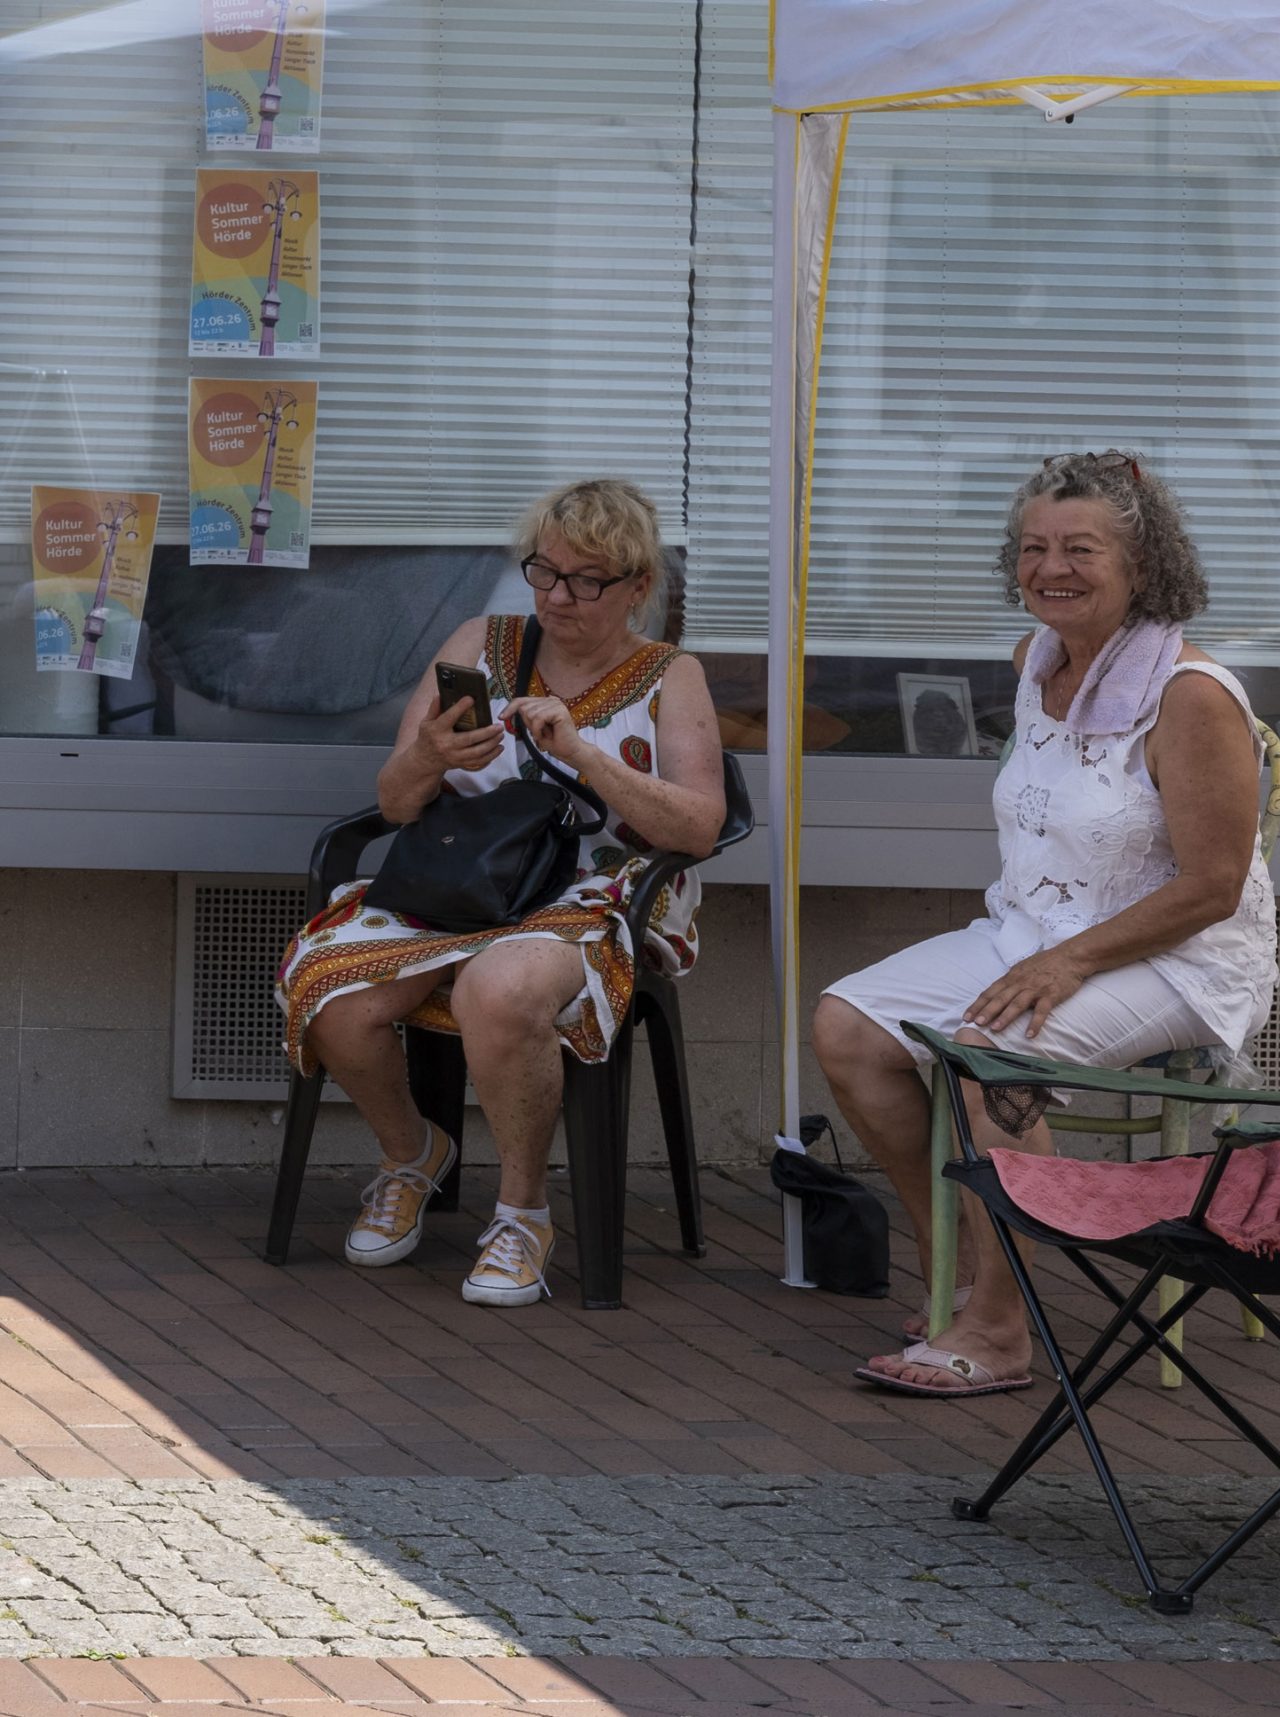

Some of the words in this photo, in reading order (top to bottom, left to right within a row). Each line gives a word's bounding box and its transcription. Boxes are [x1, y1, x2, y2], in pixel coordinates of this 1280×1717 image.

[213, 9, 264, 23] Sommer
[210, 202, 249, 215] Kultur
[211, 214, 264, 230] Sommer
[213, 229, 252, 244] Hörde
[201, 290, 235, 301] Hörder
[233, 296, 256, 332] Zentrum
[192, 313, 242, 328] 27.06.26
[207, 411, 243, 424] Kultur
[208, 424, 257, 438] Sommer
[209, 438, 245, 452] Hörde
[45, 519, 83, 531] Kultur
[225, 504, 246, 539] Zentrum
[46, 532, 96, 545] Sommer
[46, 545, 82, 558] Hörde
